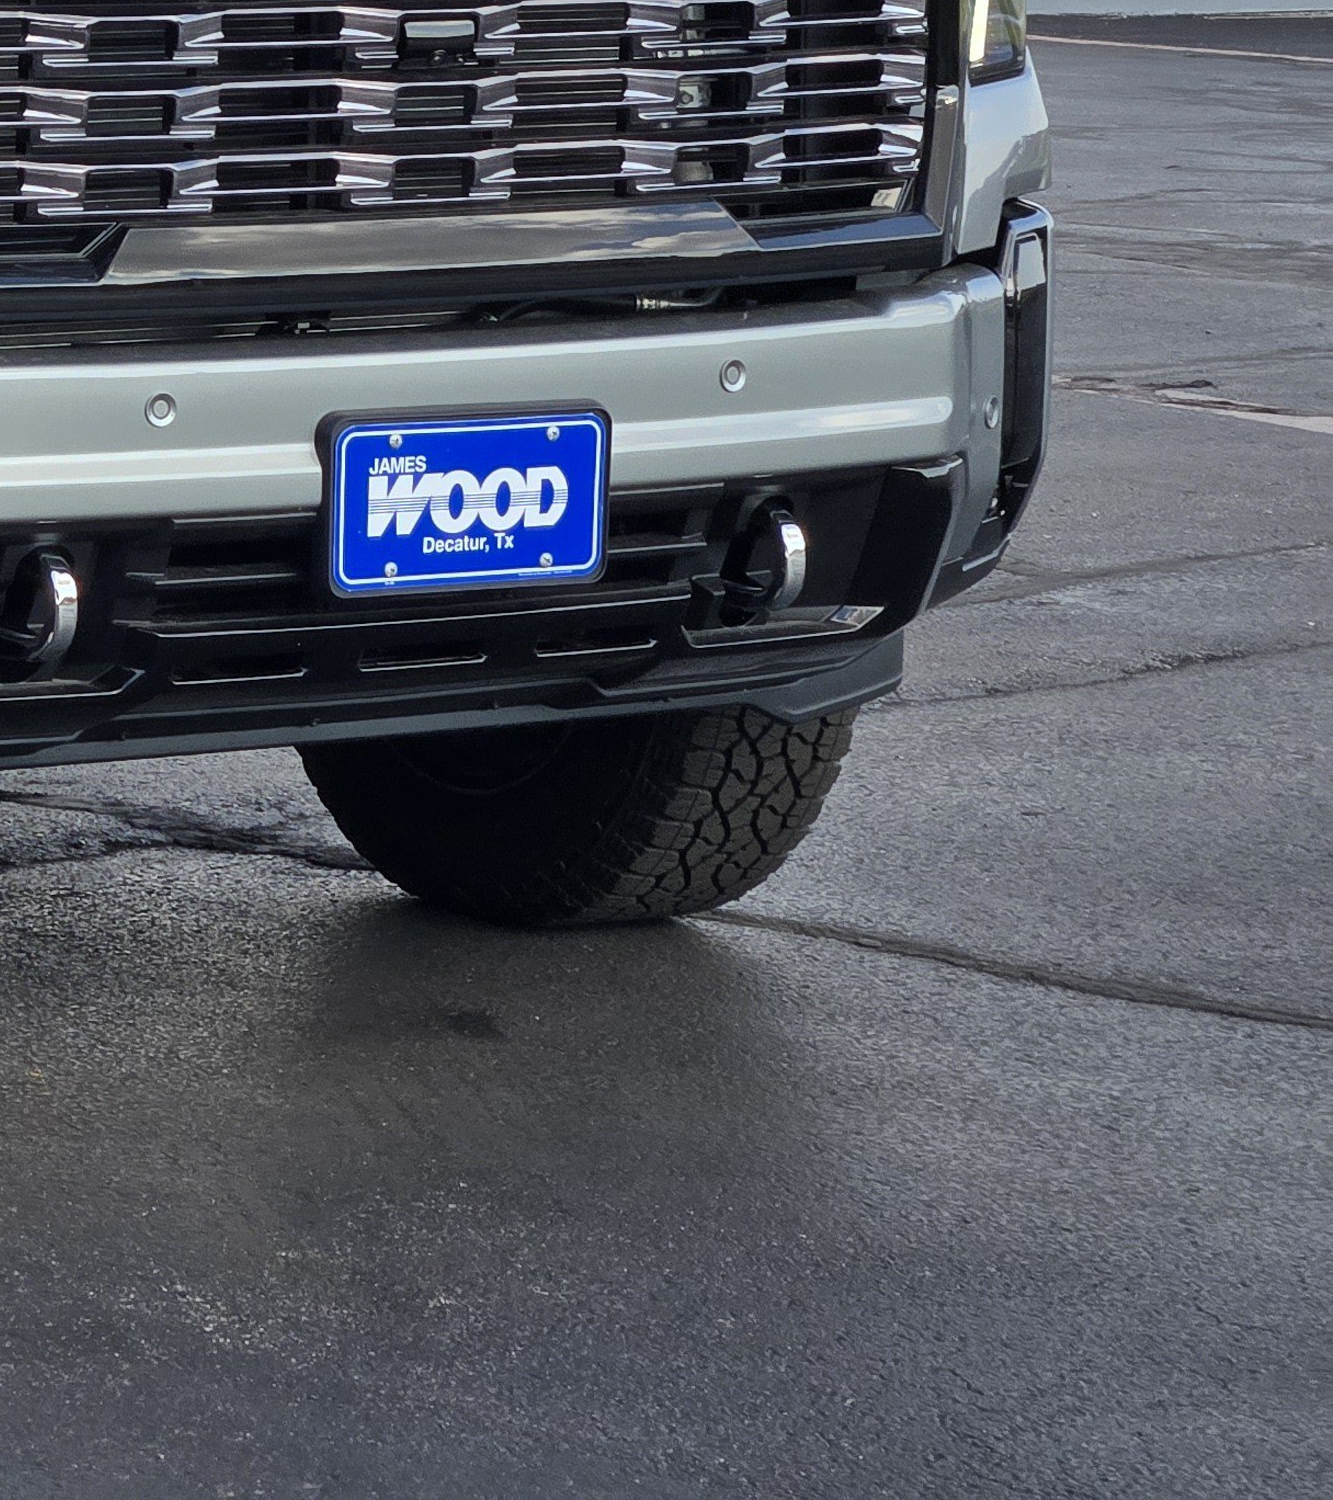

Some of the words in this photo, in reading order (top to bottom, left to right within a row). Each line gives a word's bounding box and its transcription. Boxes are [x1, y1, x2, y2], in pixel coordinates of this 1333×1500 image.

[368, 455, 427, 475] JAMES
[366, 465, 569, 538] WOOD
[422, 535, 490, 554] Decatur,
[494, 532, 515, 549] Tx
